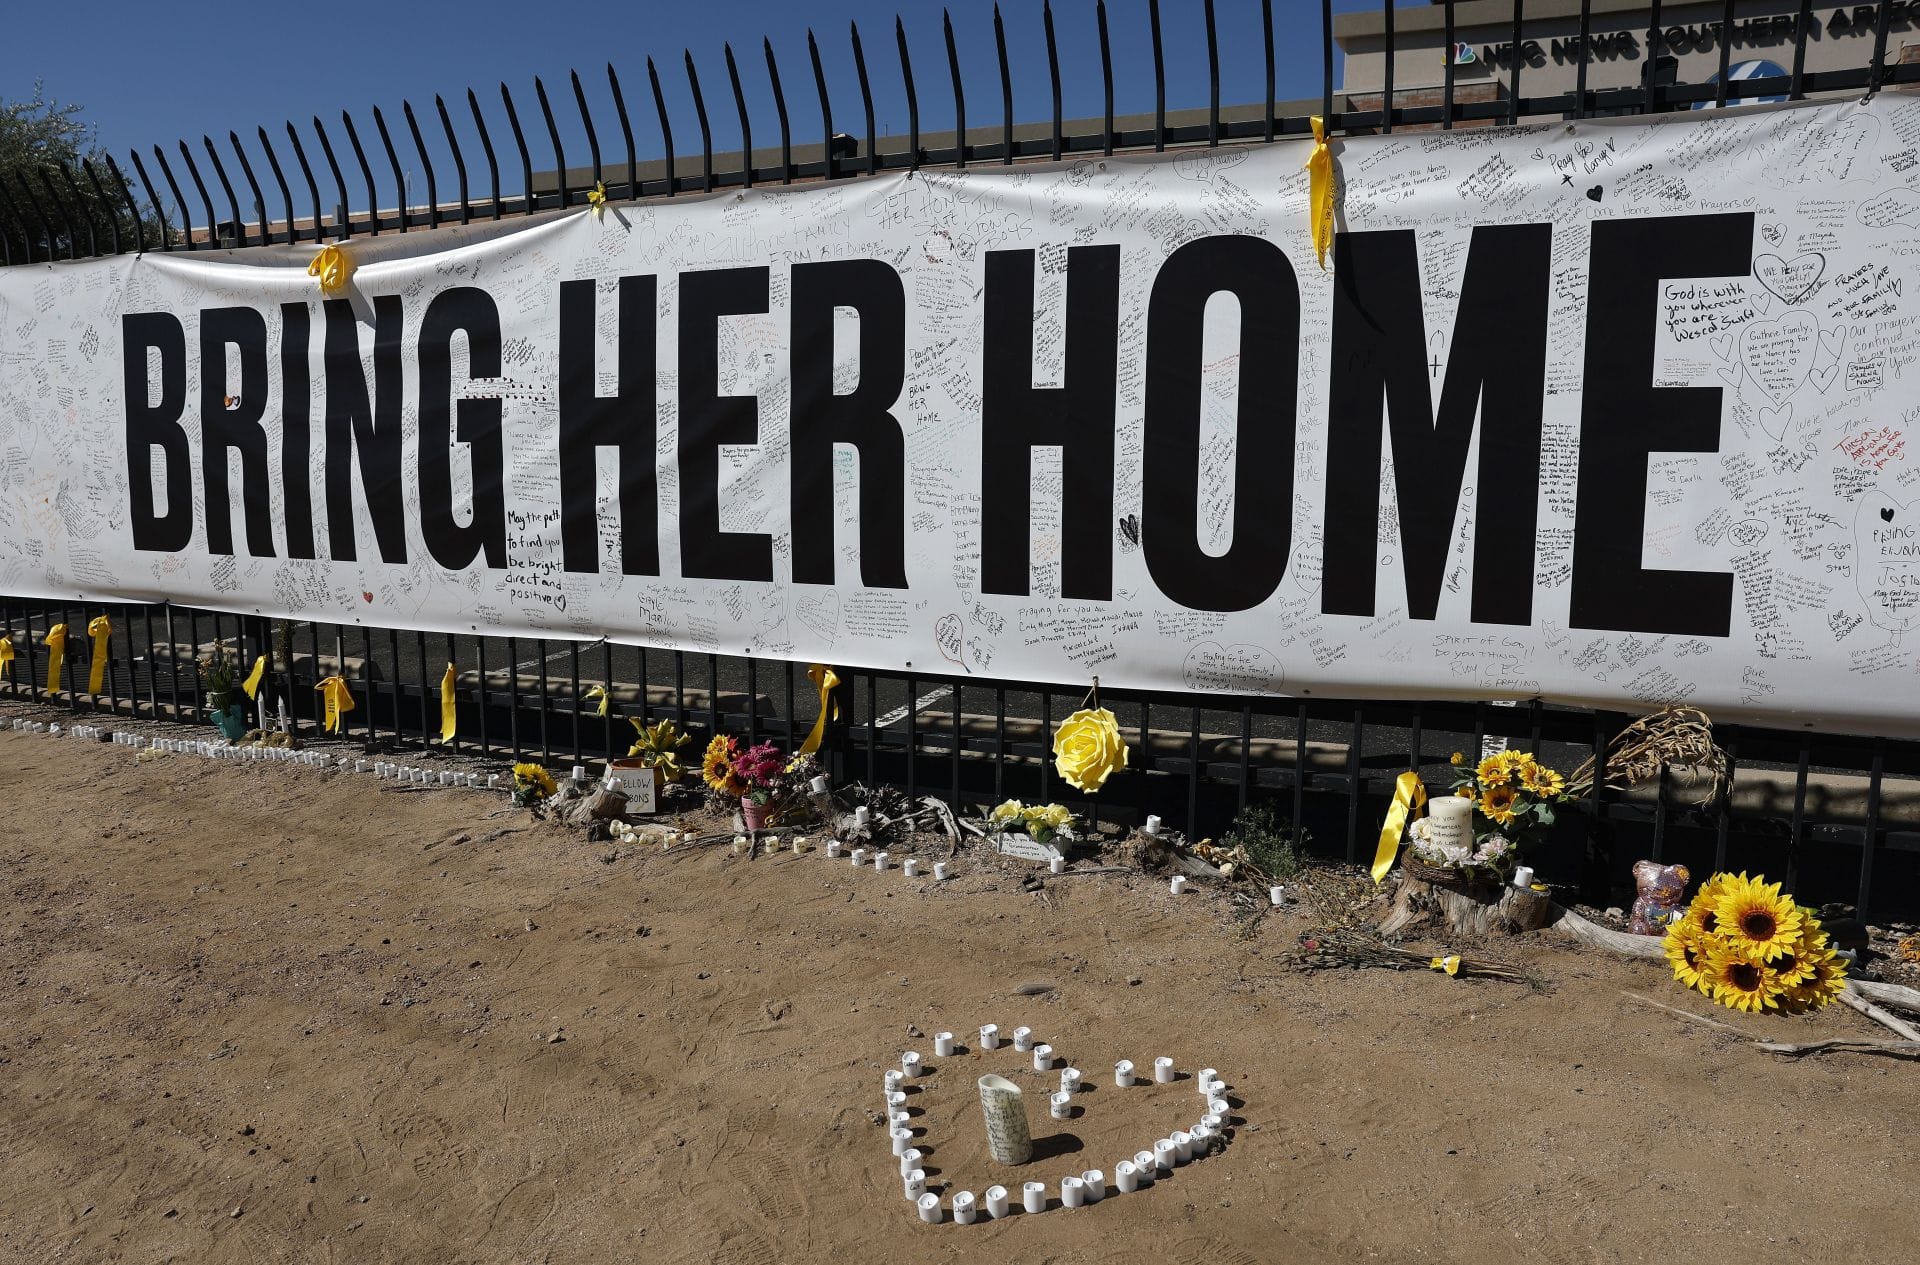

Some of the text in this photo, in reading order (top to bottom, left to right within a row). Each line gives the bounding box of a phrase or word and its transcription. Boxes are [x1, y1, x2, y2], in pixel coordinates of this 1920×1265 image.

[1586, 199, 1742, 219] Come Home Safe Prayers
[1764, 267, 1777, 277] WE
[1834, 262, 1874, 287] PRAYERS
[1873, 266, 1889, 289] LOVE
[1665, 282, 1745, 300] God is with
[1664, 297, 1747, 319] you wherever
[1665, 314, 1717, 333] you are
[1750, 321, 1812, 341] Guthrie Family,
[1772, 339, 1794, 349] praying
[122, 212, 1754, 637] BRING HER HOME
[508, 509, 560, 531] May the path
[507, 532, 560, 553] to find you
[508, 554, 525, 568] be
[505, 571, 562, 591] direct and
[510, 589, 552, 605] positive
[620, 778, 651, 789] ELLOW
[629, 793, 650, 804] BONS
